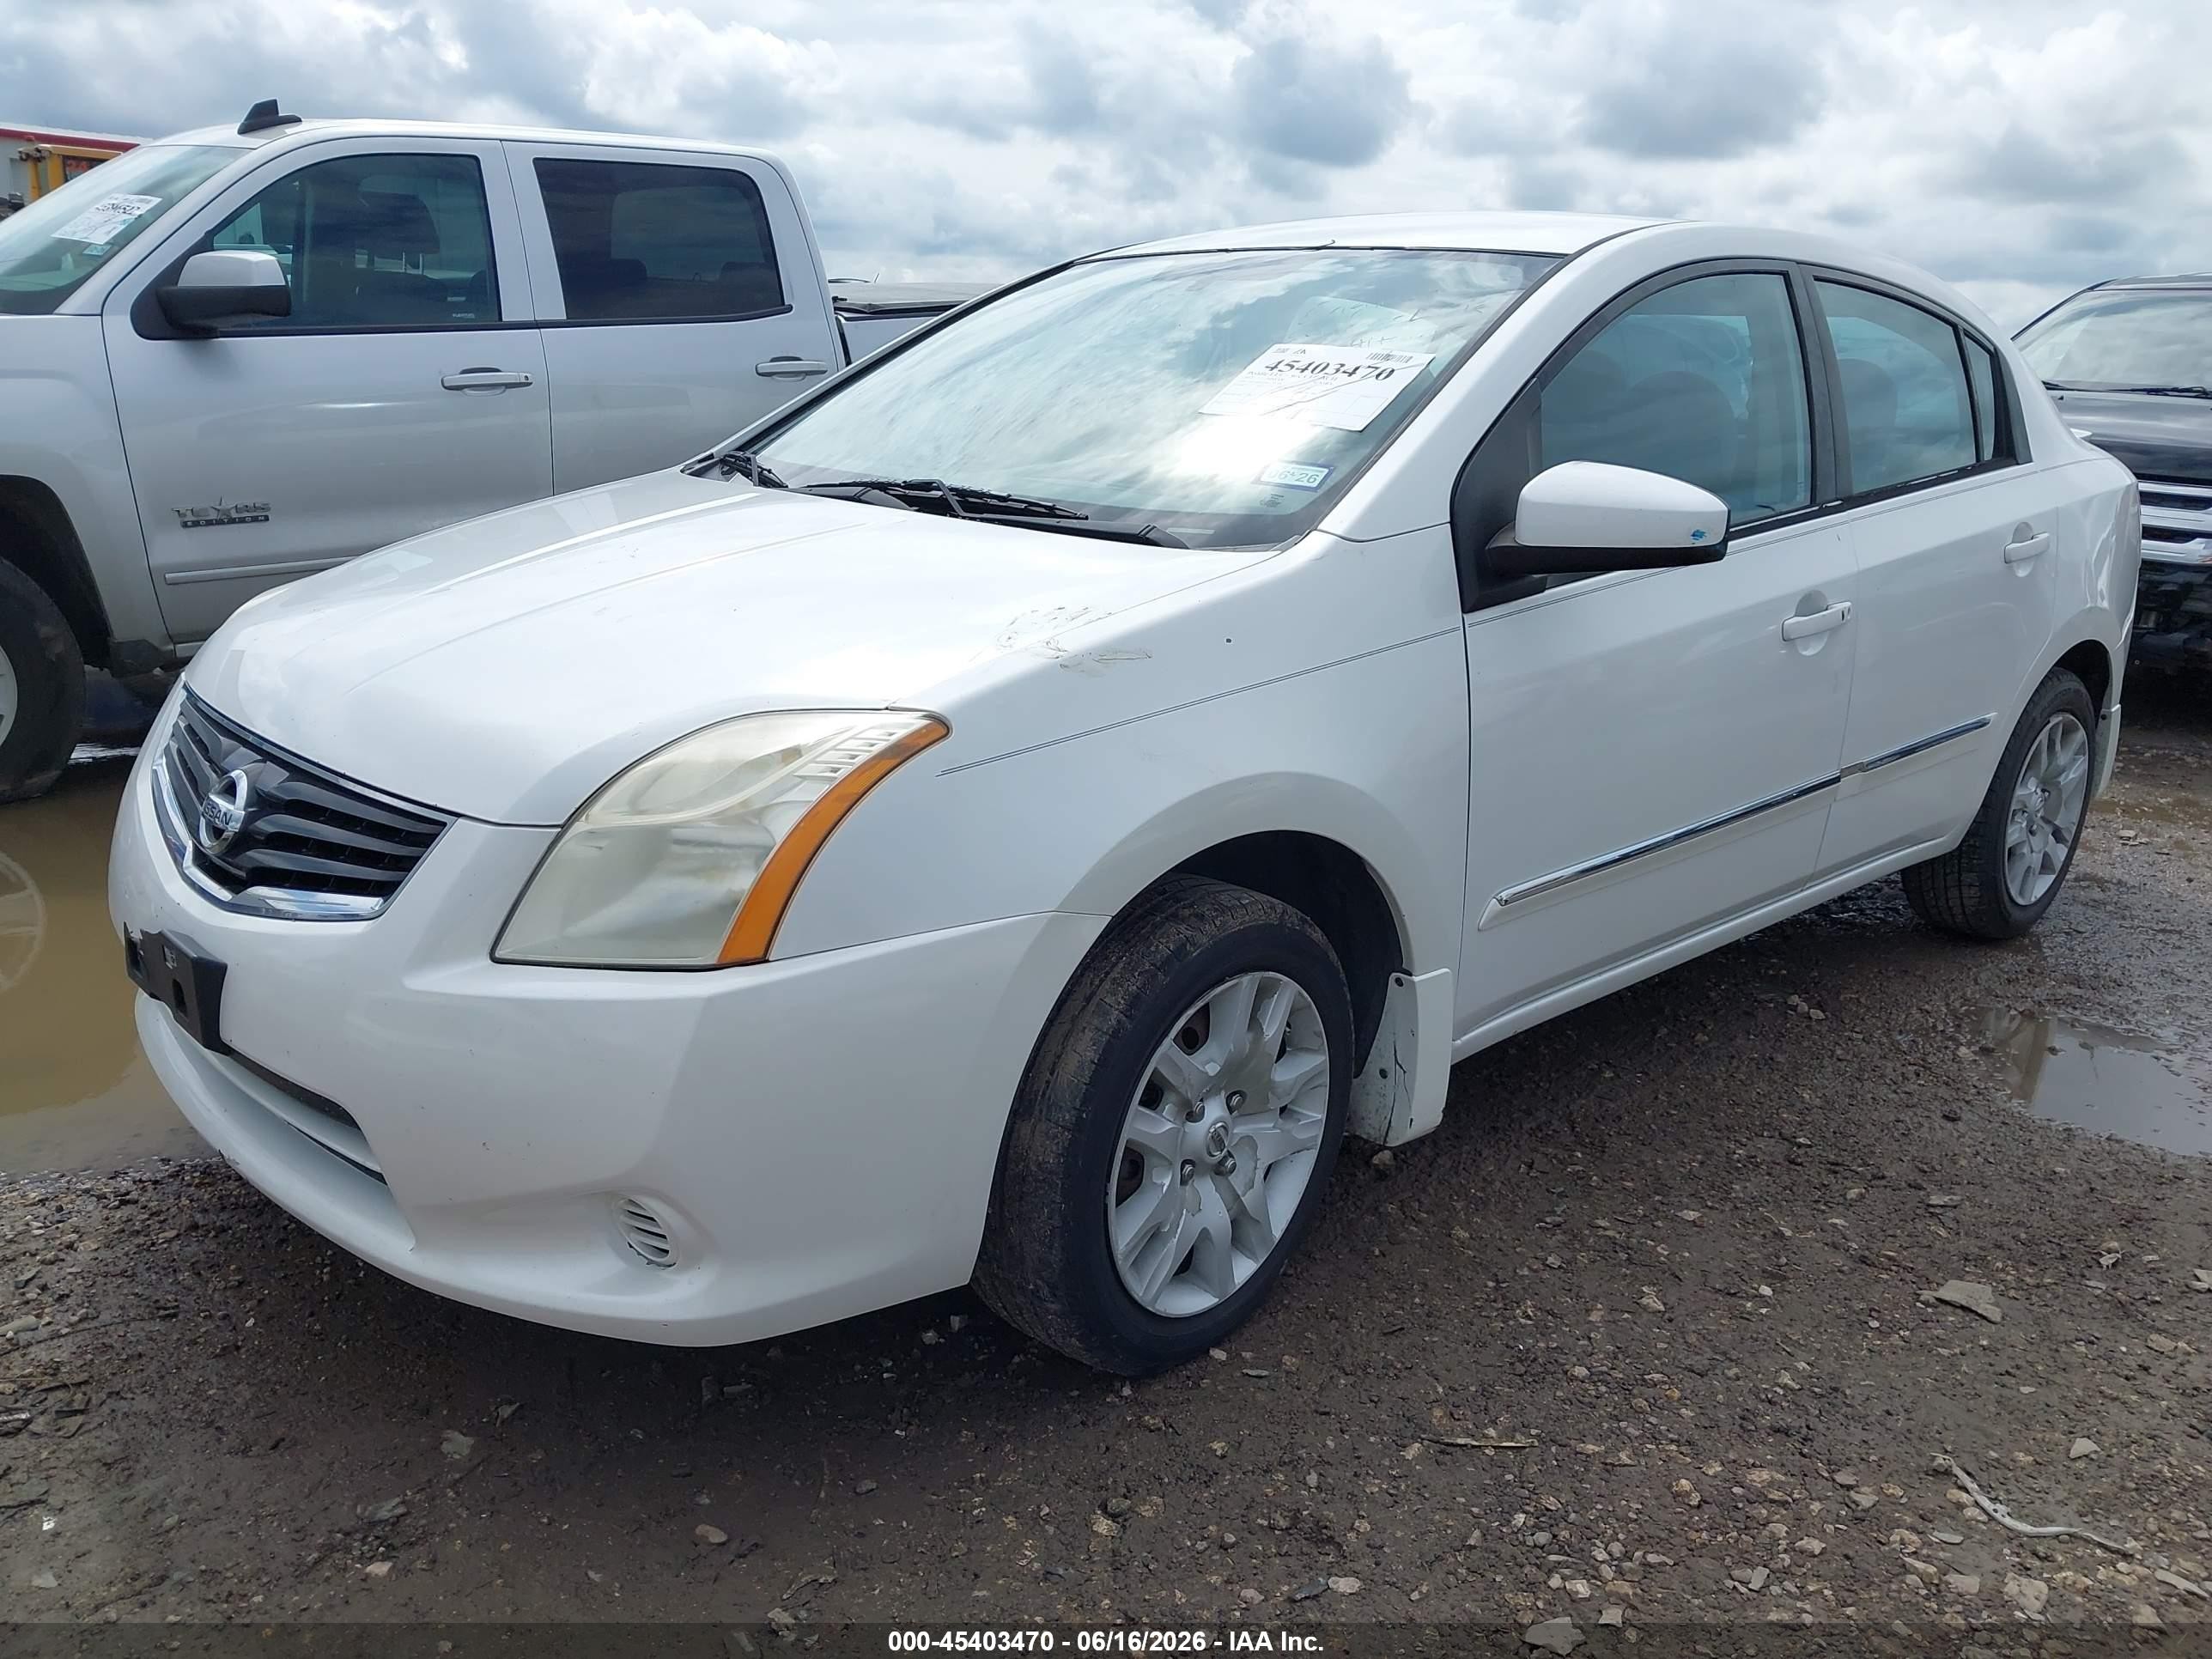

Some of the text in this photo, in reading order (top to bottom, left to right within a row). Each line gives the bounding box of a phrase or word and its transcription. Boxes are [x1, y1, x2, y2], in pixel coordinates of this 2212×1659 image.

[1265, 358, 1395, 381] 45403470
[1295, 472, 1320, 484] 26
[185, 515, 266, 526] EDITION
